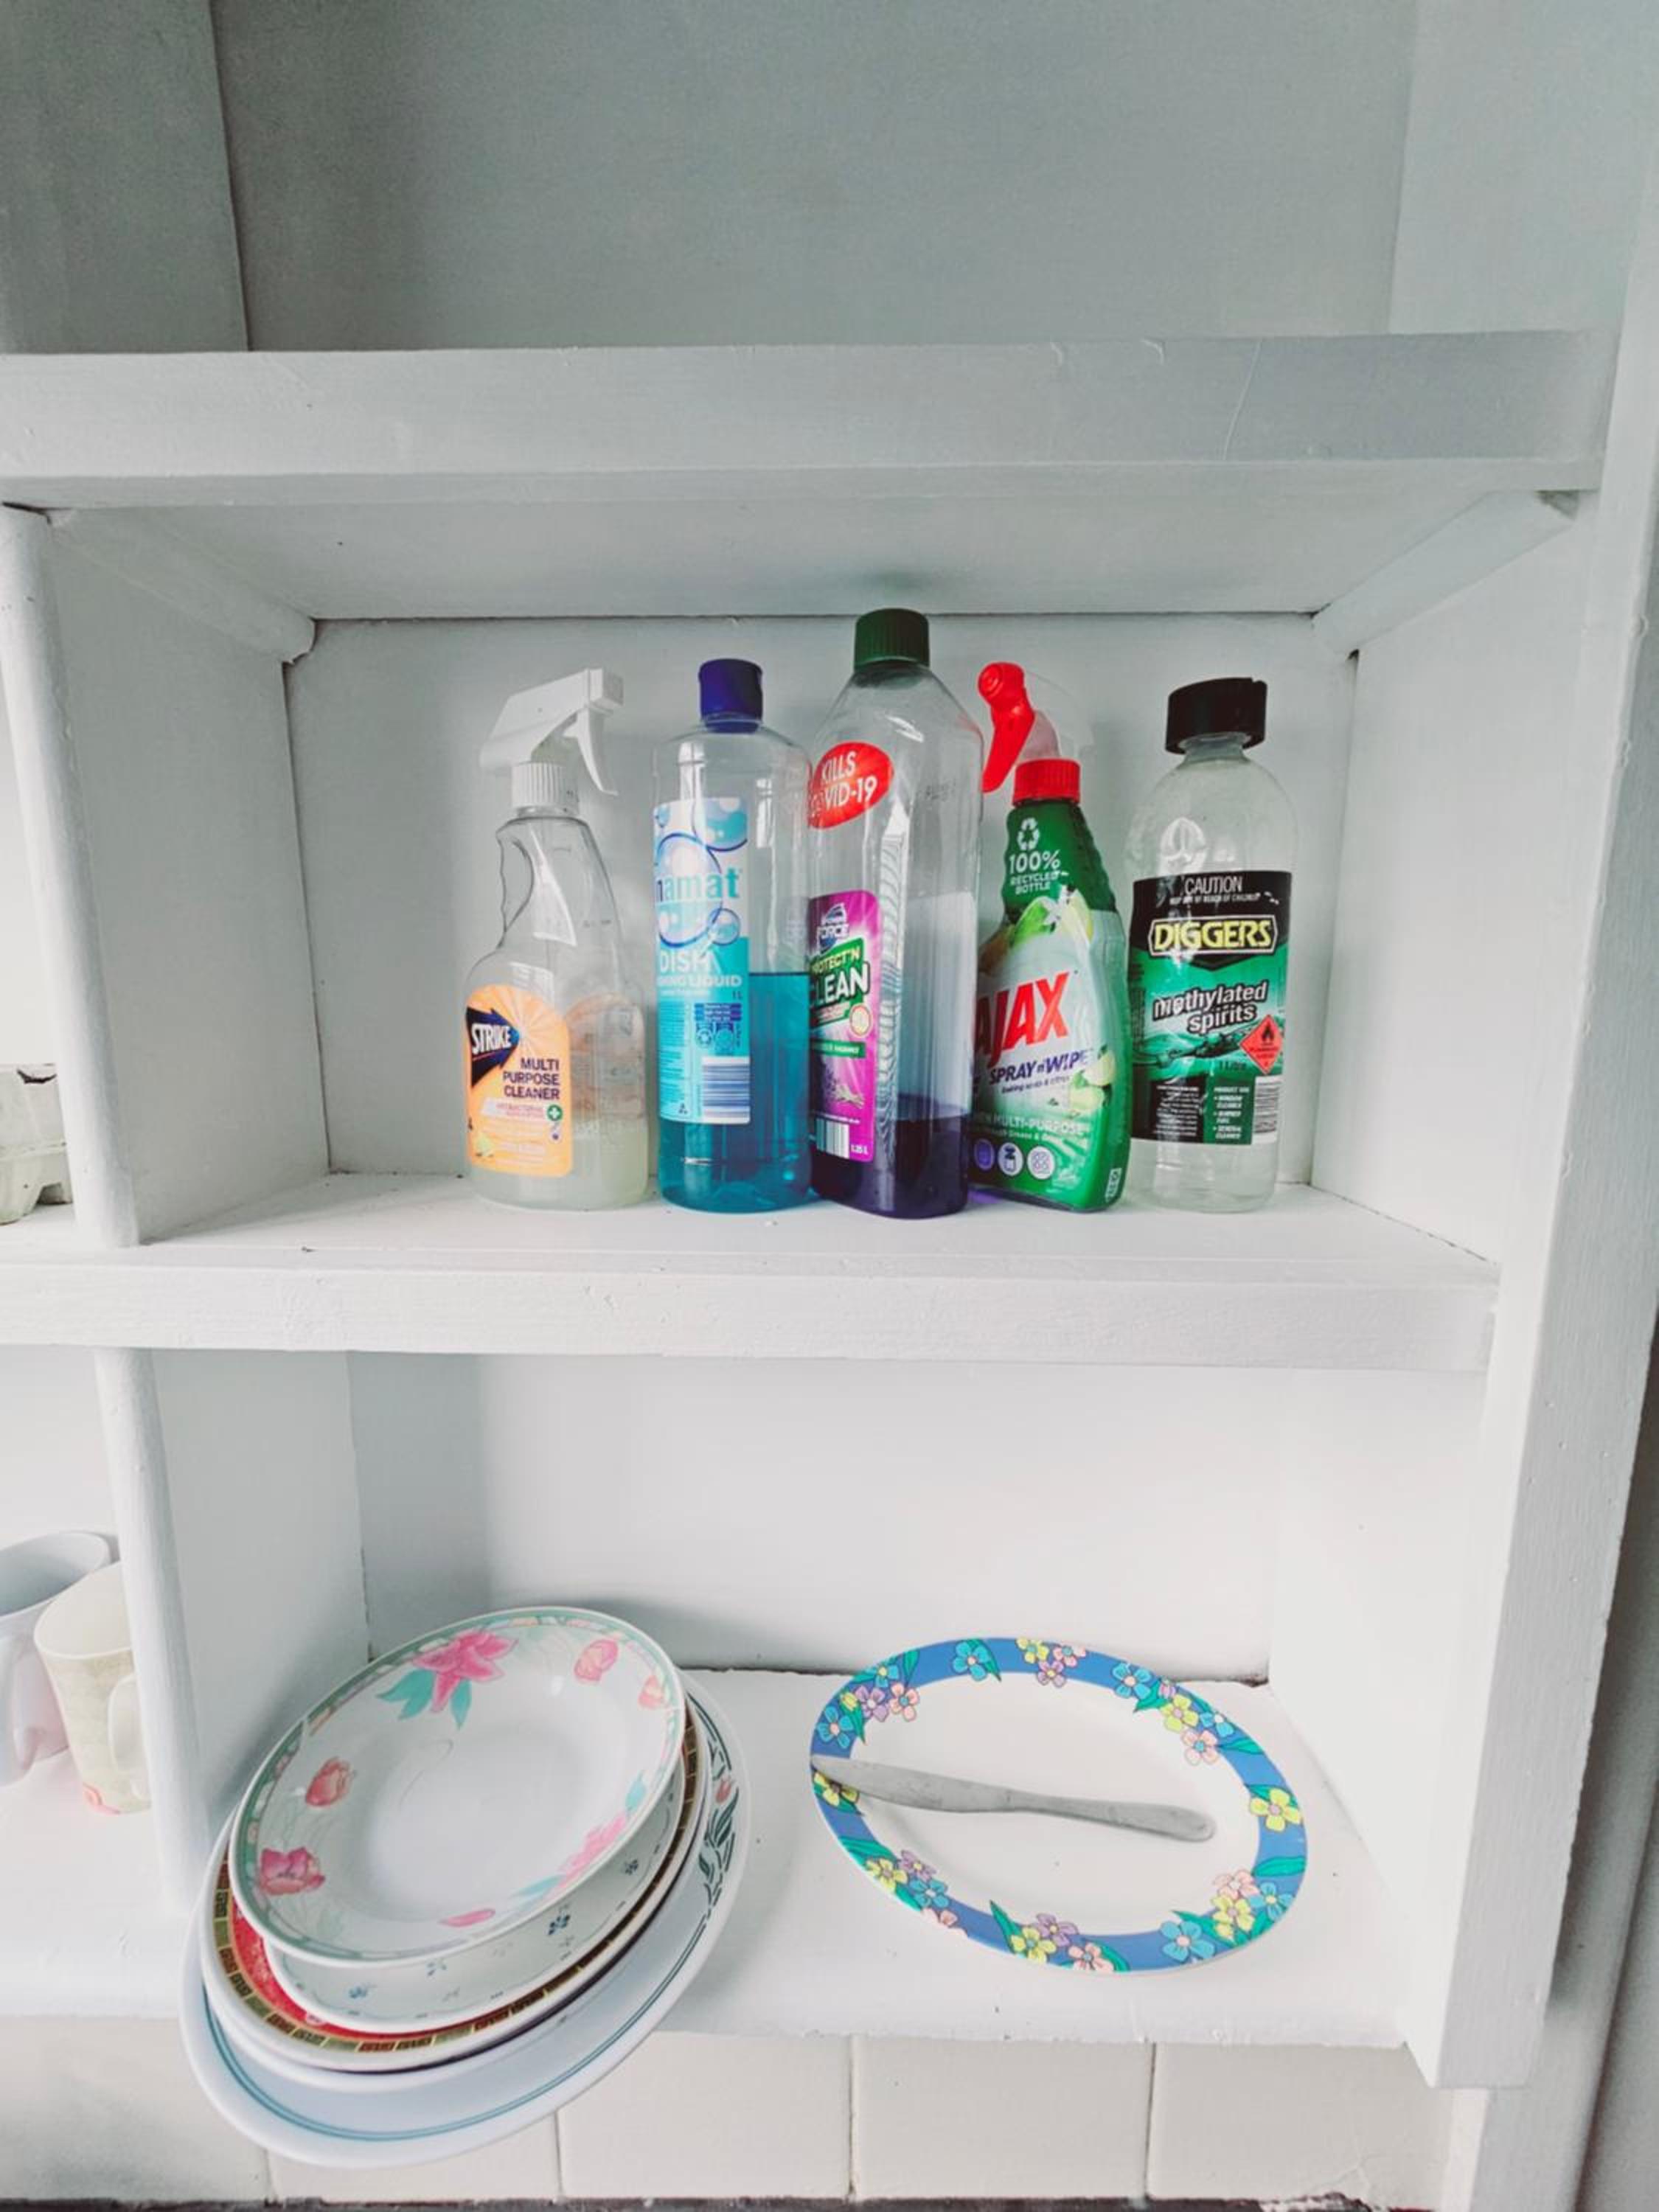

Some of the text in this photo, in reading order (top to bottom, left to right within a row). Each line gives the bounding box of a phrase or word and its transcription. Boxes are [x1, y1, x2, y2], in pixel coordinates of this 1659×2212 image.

[1009, 849, 1062, 875] 100%
[1184, 876, 1243, 895] CAUTION
[1154, 920, 1272, 950] DIGGERS
[1155, 981, 1267, 1018] methylated
[973, 971, 1070, 1069] AJAX
[1189, 1006, 1256, 1033] spirits
[470, 1022, 513, 1055] STRIKE
[520, 1058, 560, 1071] MULTI
[989, 1060, 1037, 1086] SPRAY
[503, 1071, 560, 1086] PURPOSE
[504, 1085, 560, 1100] CLEANER
